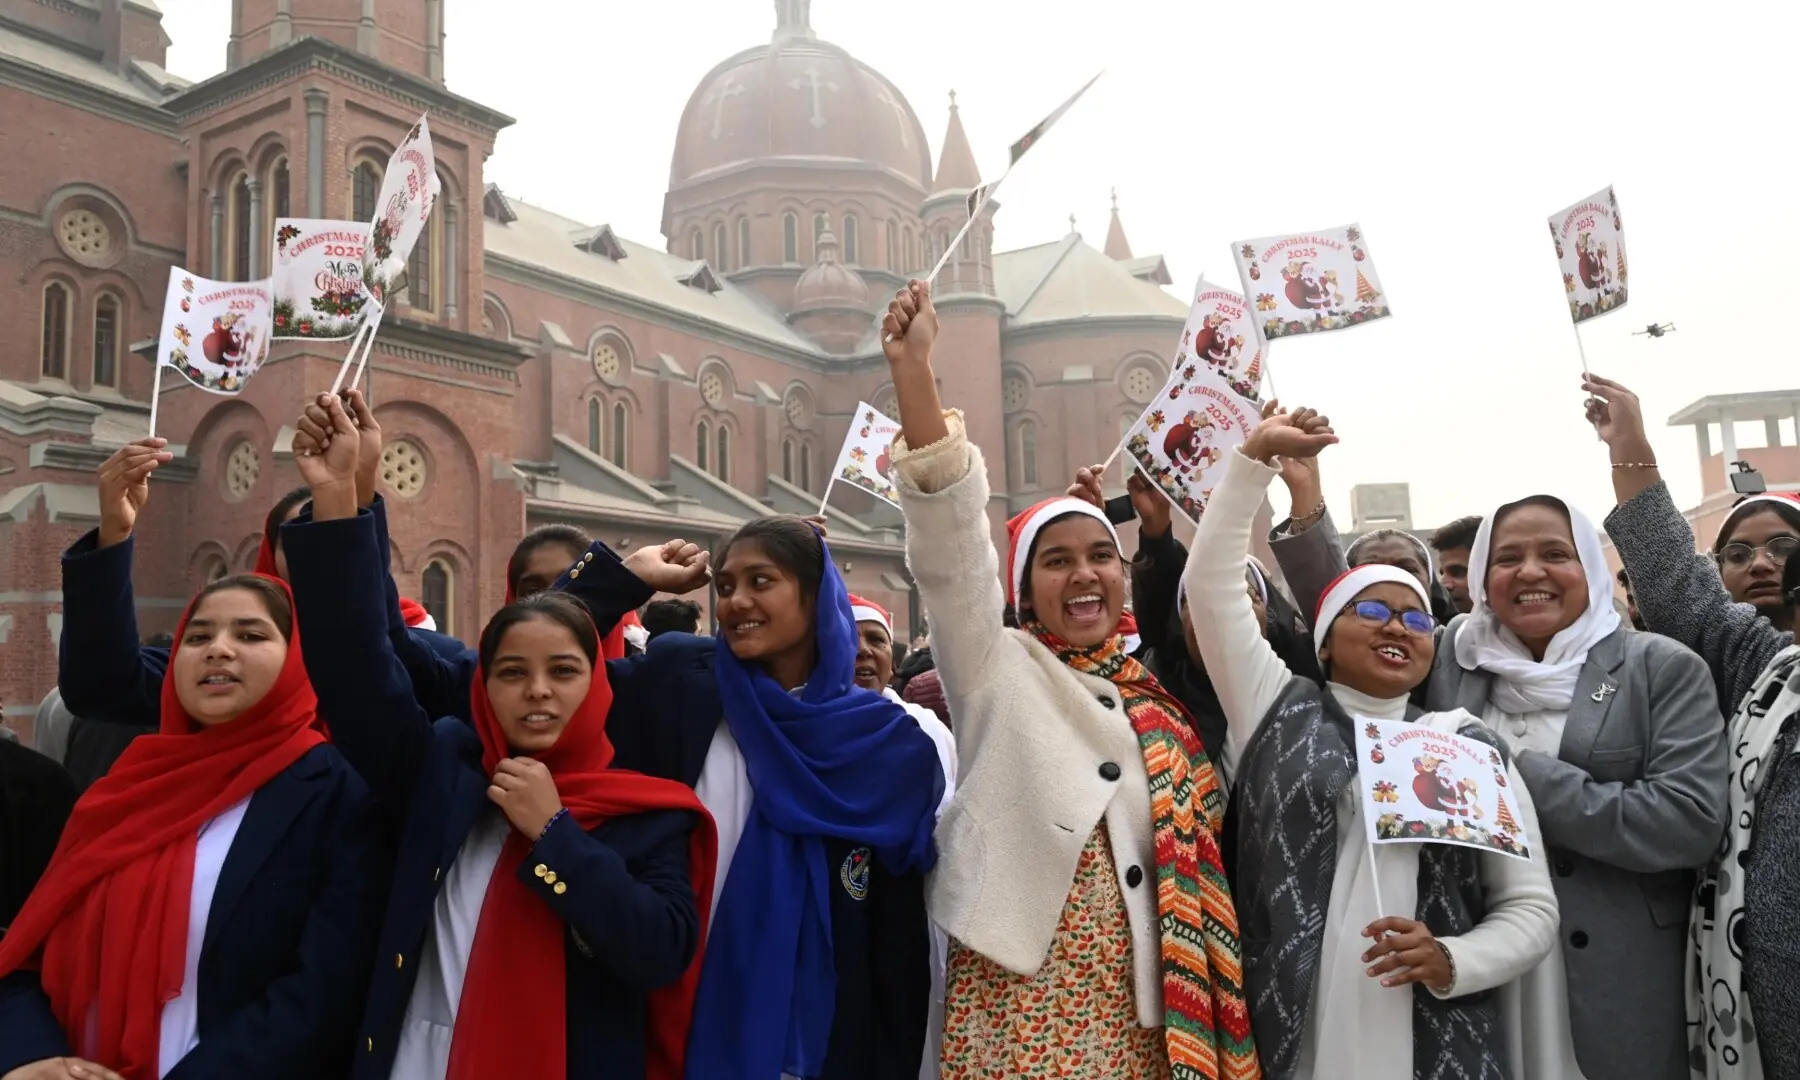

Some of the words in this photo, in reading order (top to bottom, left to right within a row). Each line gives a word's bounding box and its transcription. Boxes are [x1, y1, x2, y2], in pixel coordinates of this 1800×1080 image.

[1576, 215, 1595, 232] 2025
[290, 231, 360, 257] CHRISTMAS
[324, 245, 364, 260] 2025
[1262, 236, 1310, 263] CHRISTMAS
[1311, 236, 1345, 252] RALLY
[1287, 247, 1318, 260] 2025
[314, 270, 364, 293] Christma
[1197, 291, 1242, 304] CHRISTMAS
[1215, 302, 1242, 319] 2025
[1188, 386, 1241, 416] CHRISTMAS
[1236, 413, 1251, 440] RAL
[1206, 403, 1234, 431] 2025
[1388, 729, 1450, 748] CHRISTMAS
[1451, 738, 1487, 765] RALLY
[1422, 742, 1458, 760] 2025
